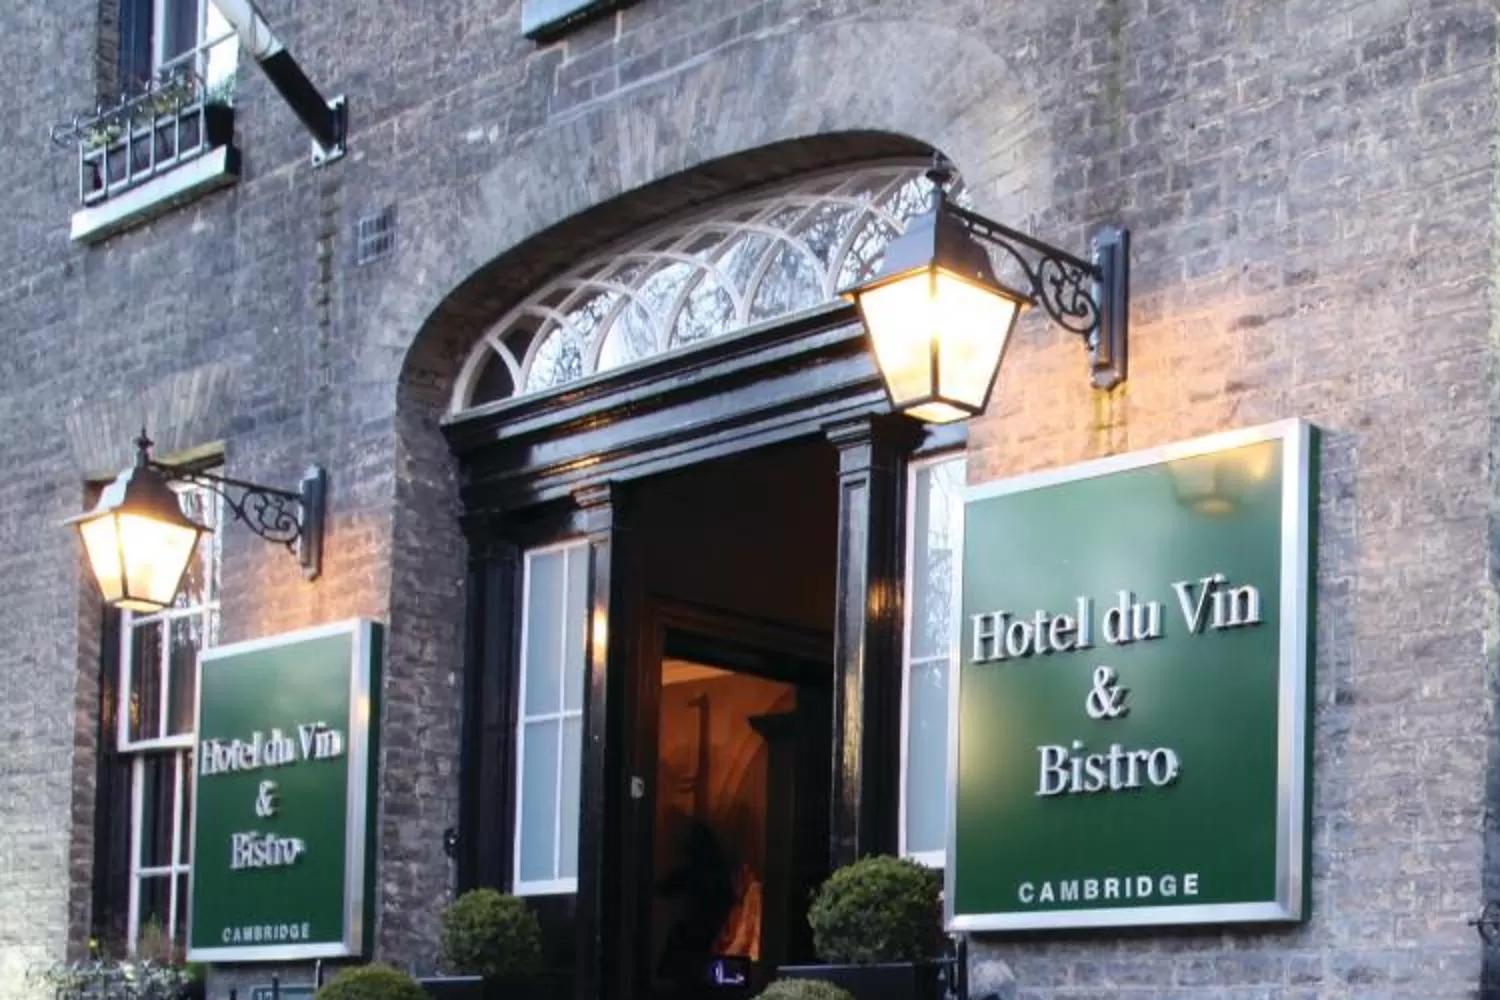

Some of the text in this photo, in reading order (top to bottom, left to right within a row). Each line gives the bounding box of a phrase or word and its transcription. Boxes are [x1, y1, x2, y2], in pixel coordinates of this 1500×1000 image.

[970, 573, 1260, 661] Hotel du Vin
[1086, 666, 1127, 719] &
[201, 720, 342, 775] Hotel du Vin
[1036, 740, 1177, 796] Bistro
[256, 780, 278, 817] &
[230, 830, 305, 870] Bistro
[1018, 873, 1199, 903] CAMBRIDGE
[222, 922, 310, 943] CAMBRIDGE
